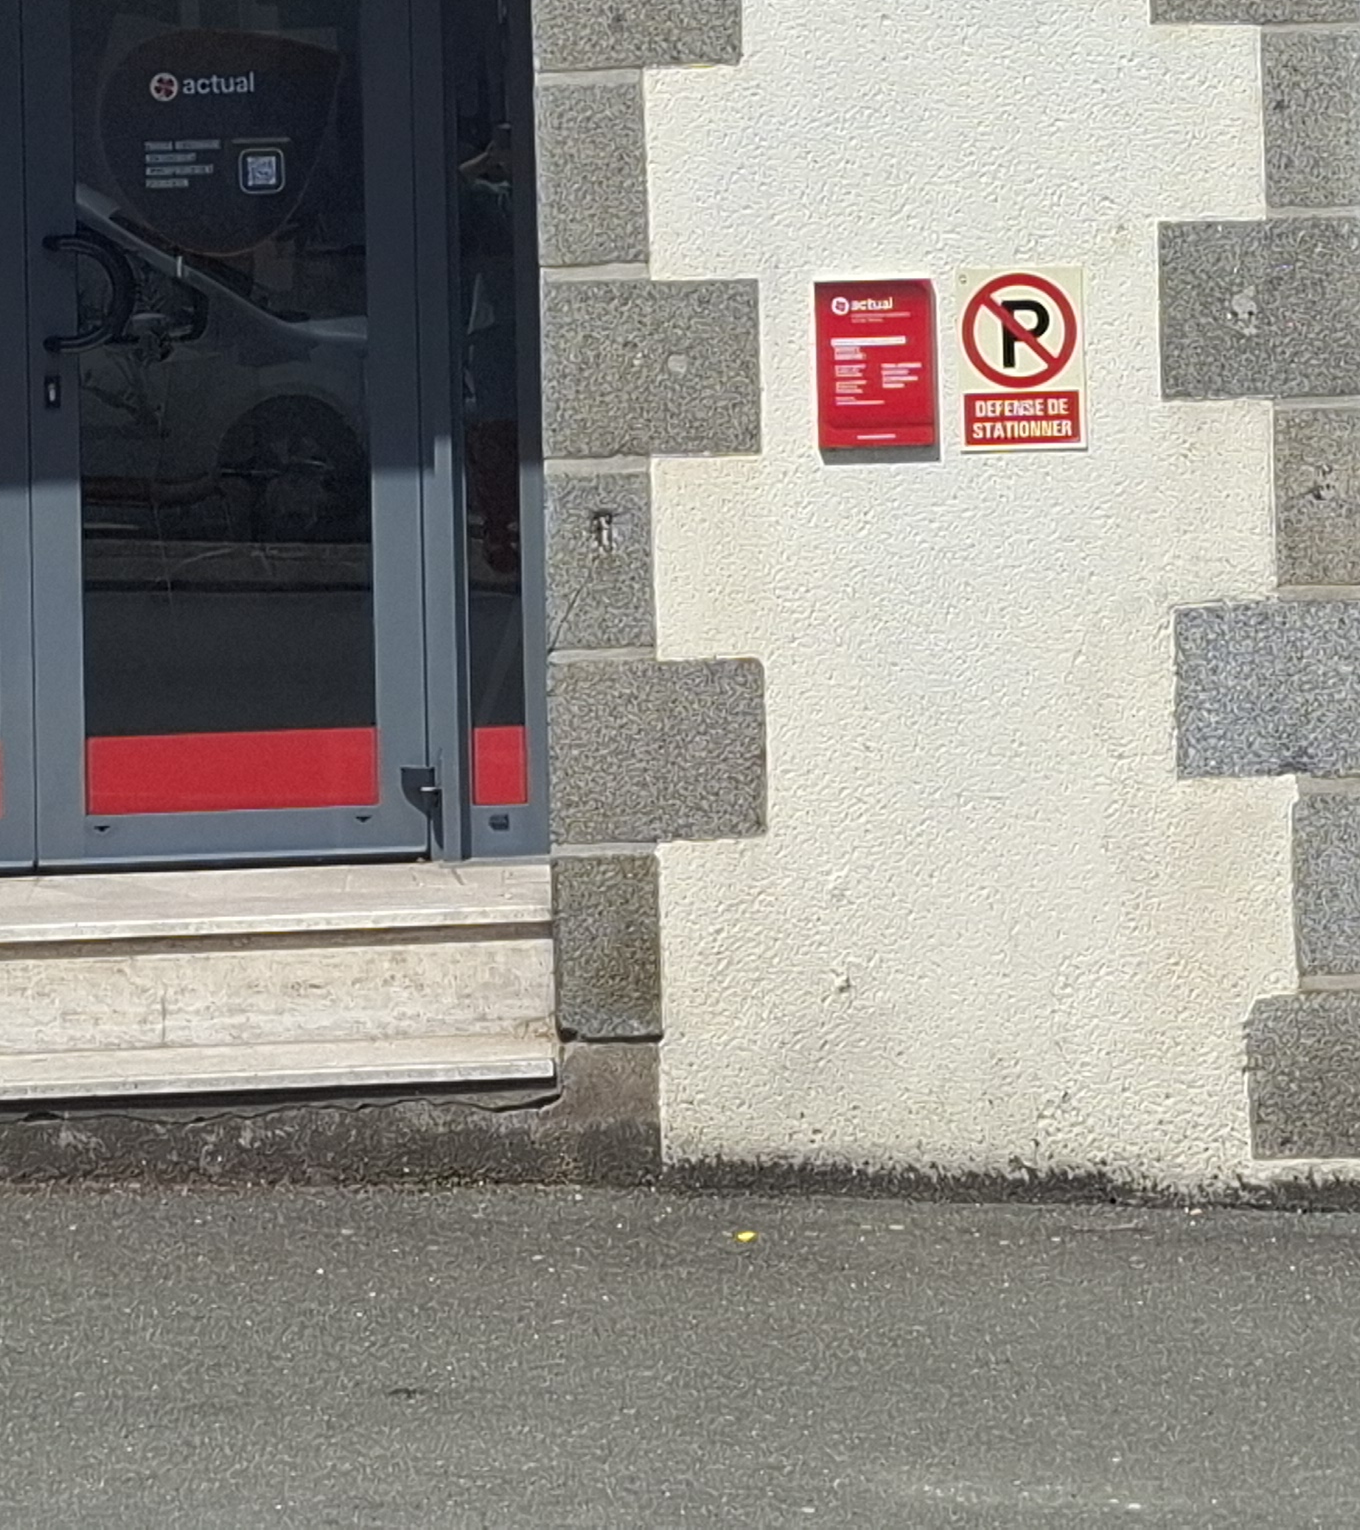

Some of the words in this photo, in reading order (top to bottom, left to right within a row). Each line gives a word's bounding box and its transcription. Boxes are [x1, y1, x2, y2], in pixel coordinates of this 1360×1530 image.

[182, 70, 255, 94] actual
[850, 296, 893, 310] actual
[975, 399, 1044, 417] DEFENSE
[1047, 398, 1069, 415] DE
[972, 420, 1073, 439] STATIONNER
